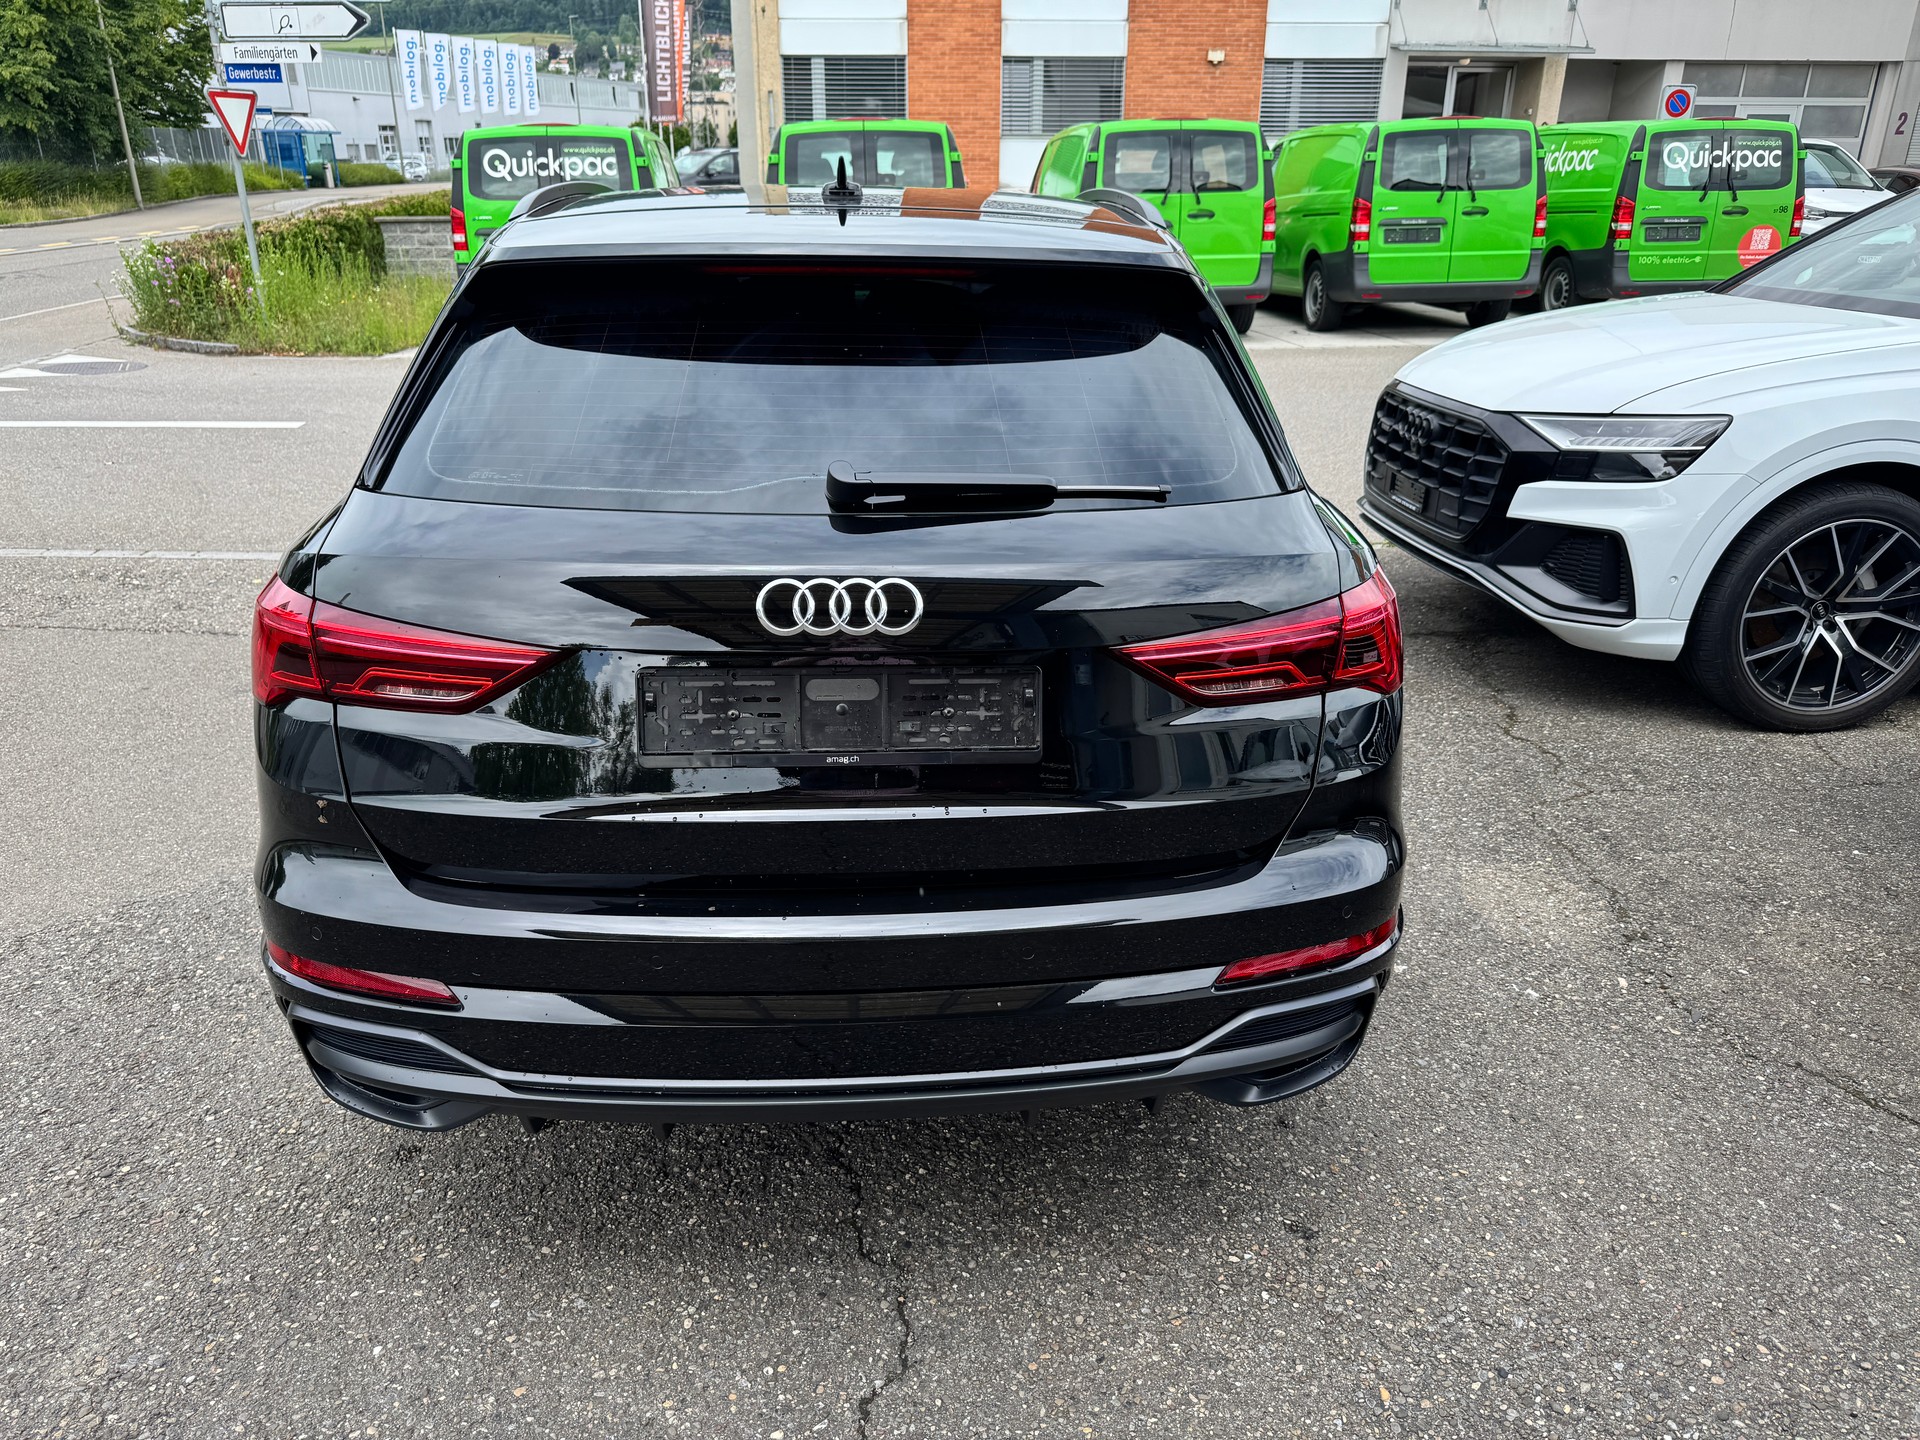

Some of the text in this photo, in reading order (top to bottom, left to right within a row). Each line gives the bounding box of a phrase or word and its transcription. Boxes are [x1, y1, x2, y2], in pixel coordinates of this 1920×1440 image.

[233, 46, 299, 62] Familiengärten
[228, 66, 280, 81] Gewerbestr.
[1894, 112, 1908, 135] 2
[1662, 141, 1782, 172] Quickpac
[482, 148, 617, 181] Quickpac
[1778, 205, 1789, 214] 98
[1638, 255, 1690, 264] 100% electric
[826, 755, 859, 764] amag.ch
